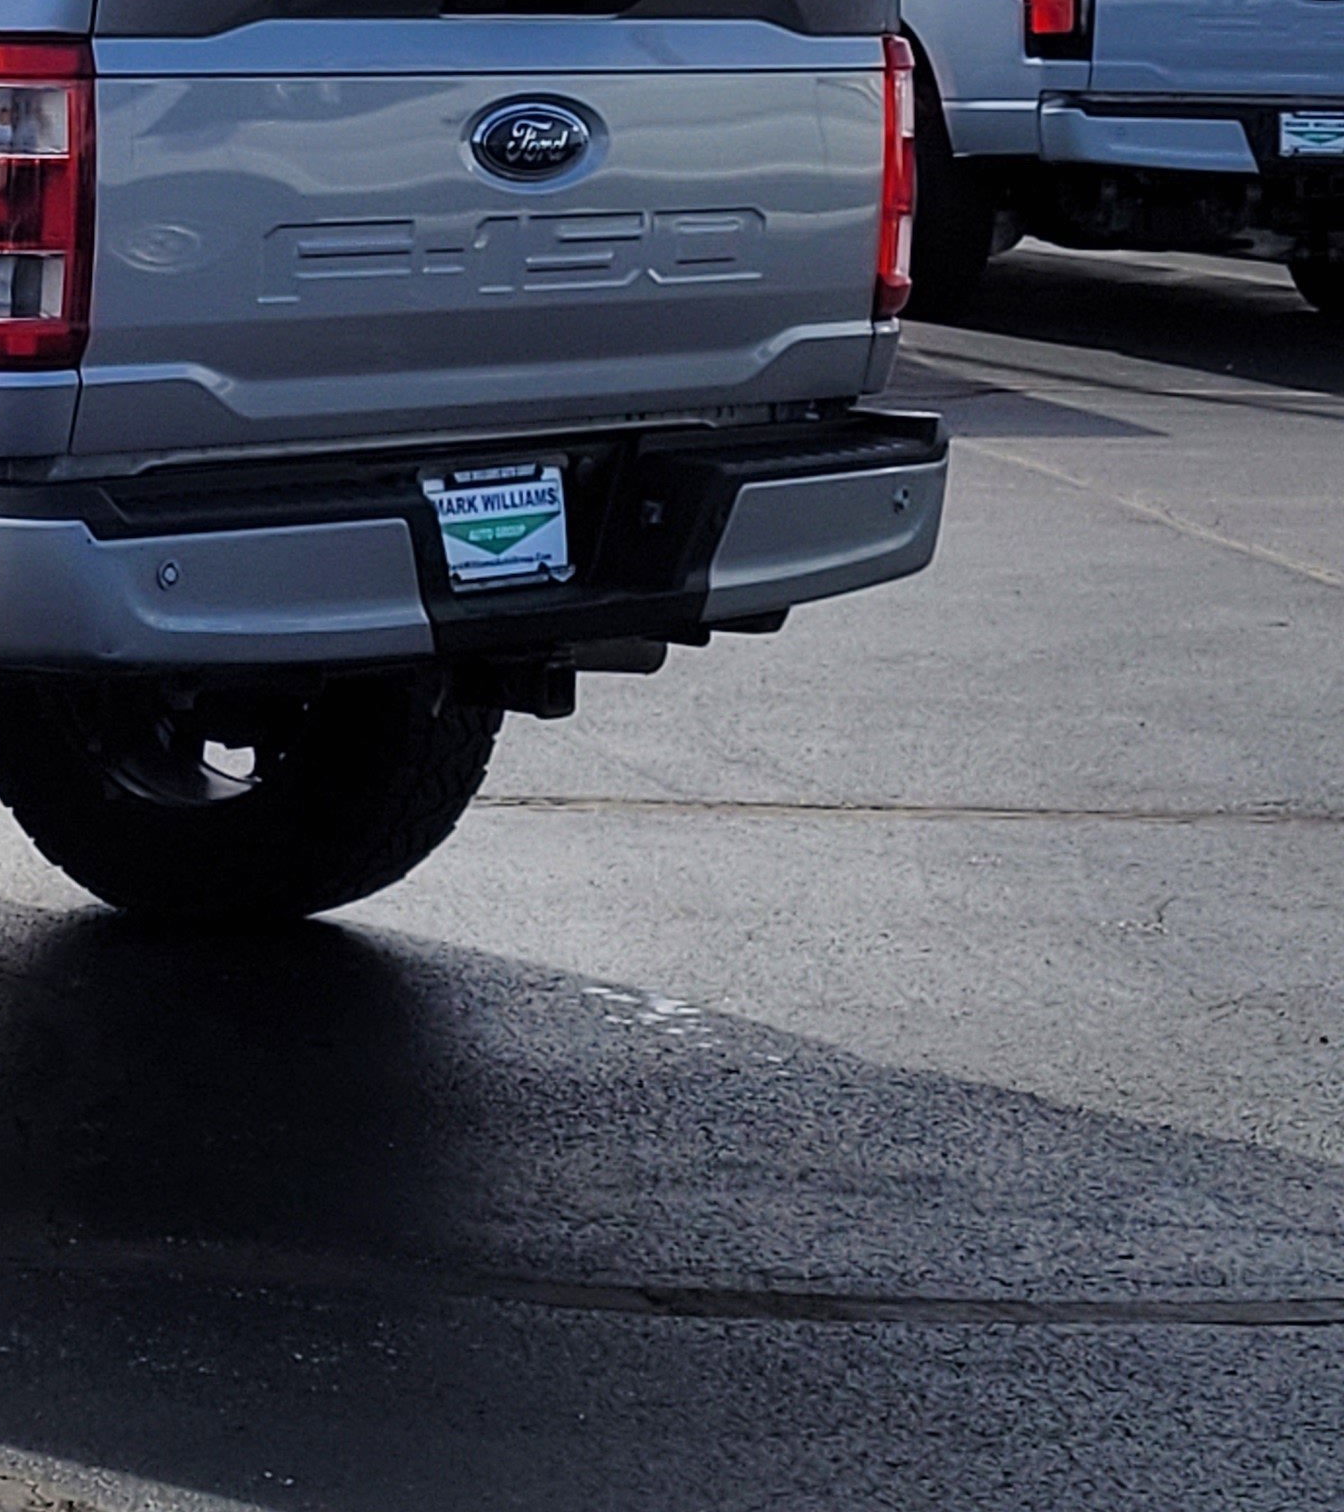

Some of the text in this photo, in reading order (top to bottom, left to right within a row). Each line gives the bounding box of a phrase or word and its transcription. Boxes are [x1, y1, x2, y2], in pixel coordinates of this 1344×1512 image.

[505, 118, 569, 163] Ford
[257, 206, 767, 305] F-150
[481, 487, 558, 512] WILLIAMS
